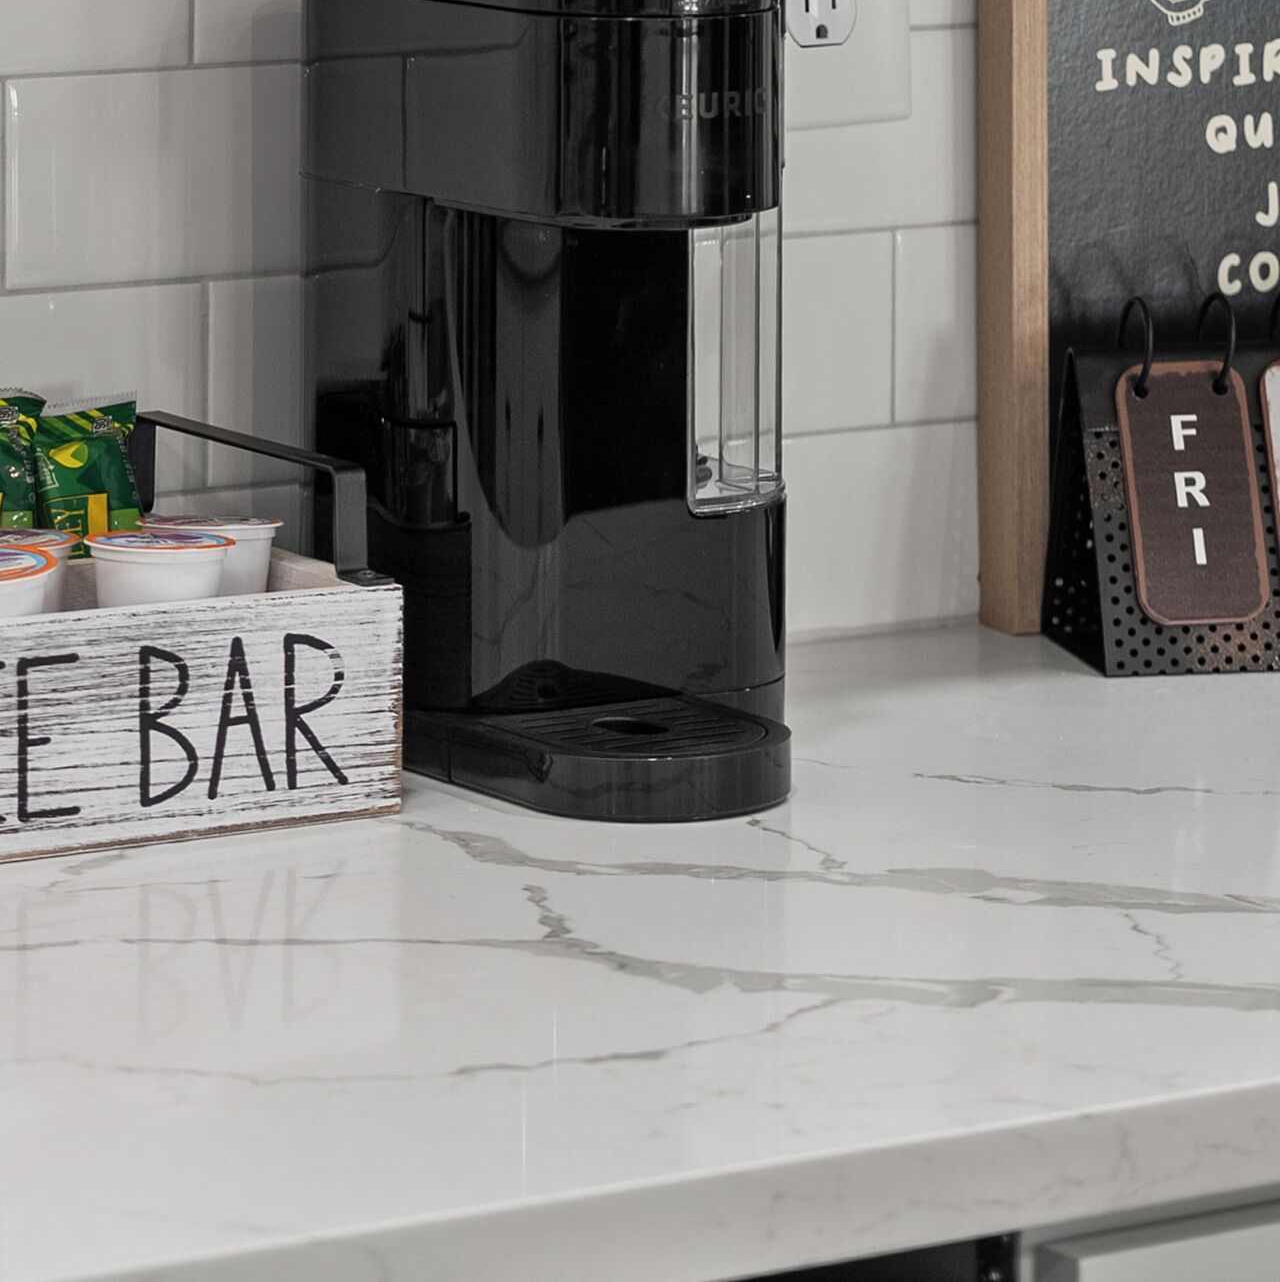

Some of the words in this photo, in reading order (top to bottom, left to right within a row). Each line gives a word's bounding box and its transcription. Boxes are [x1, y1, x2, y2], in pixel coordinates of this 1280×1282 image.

[657, 86, 769, 123] EURIG
[1167, 412, 1211, 567] FRI
[138, 631, 350, 808] BAR
